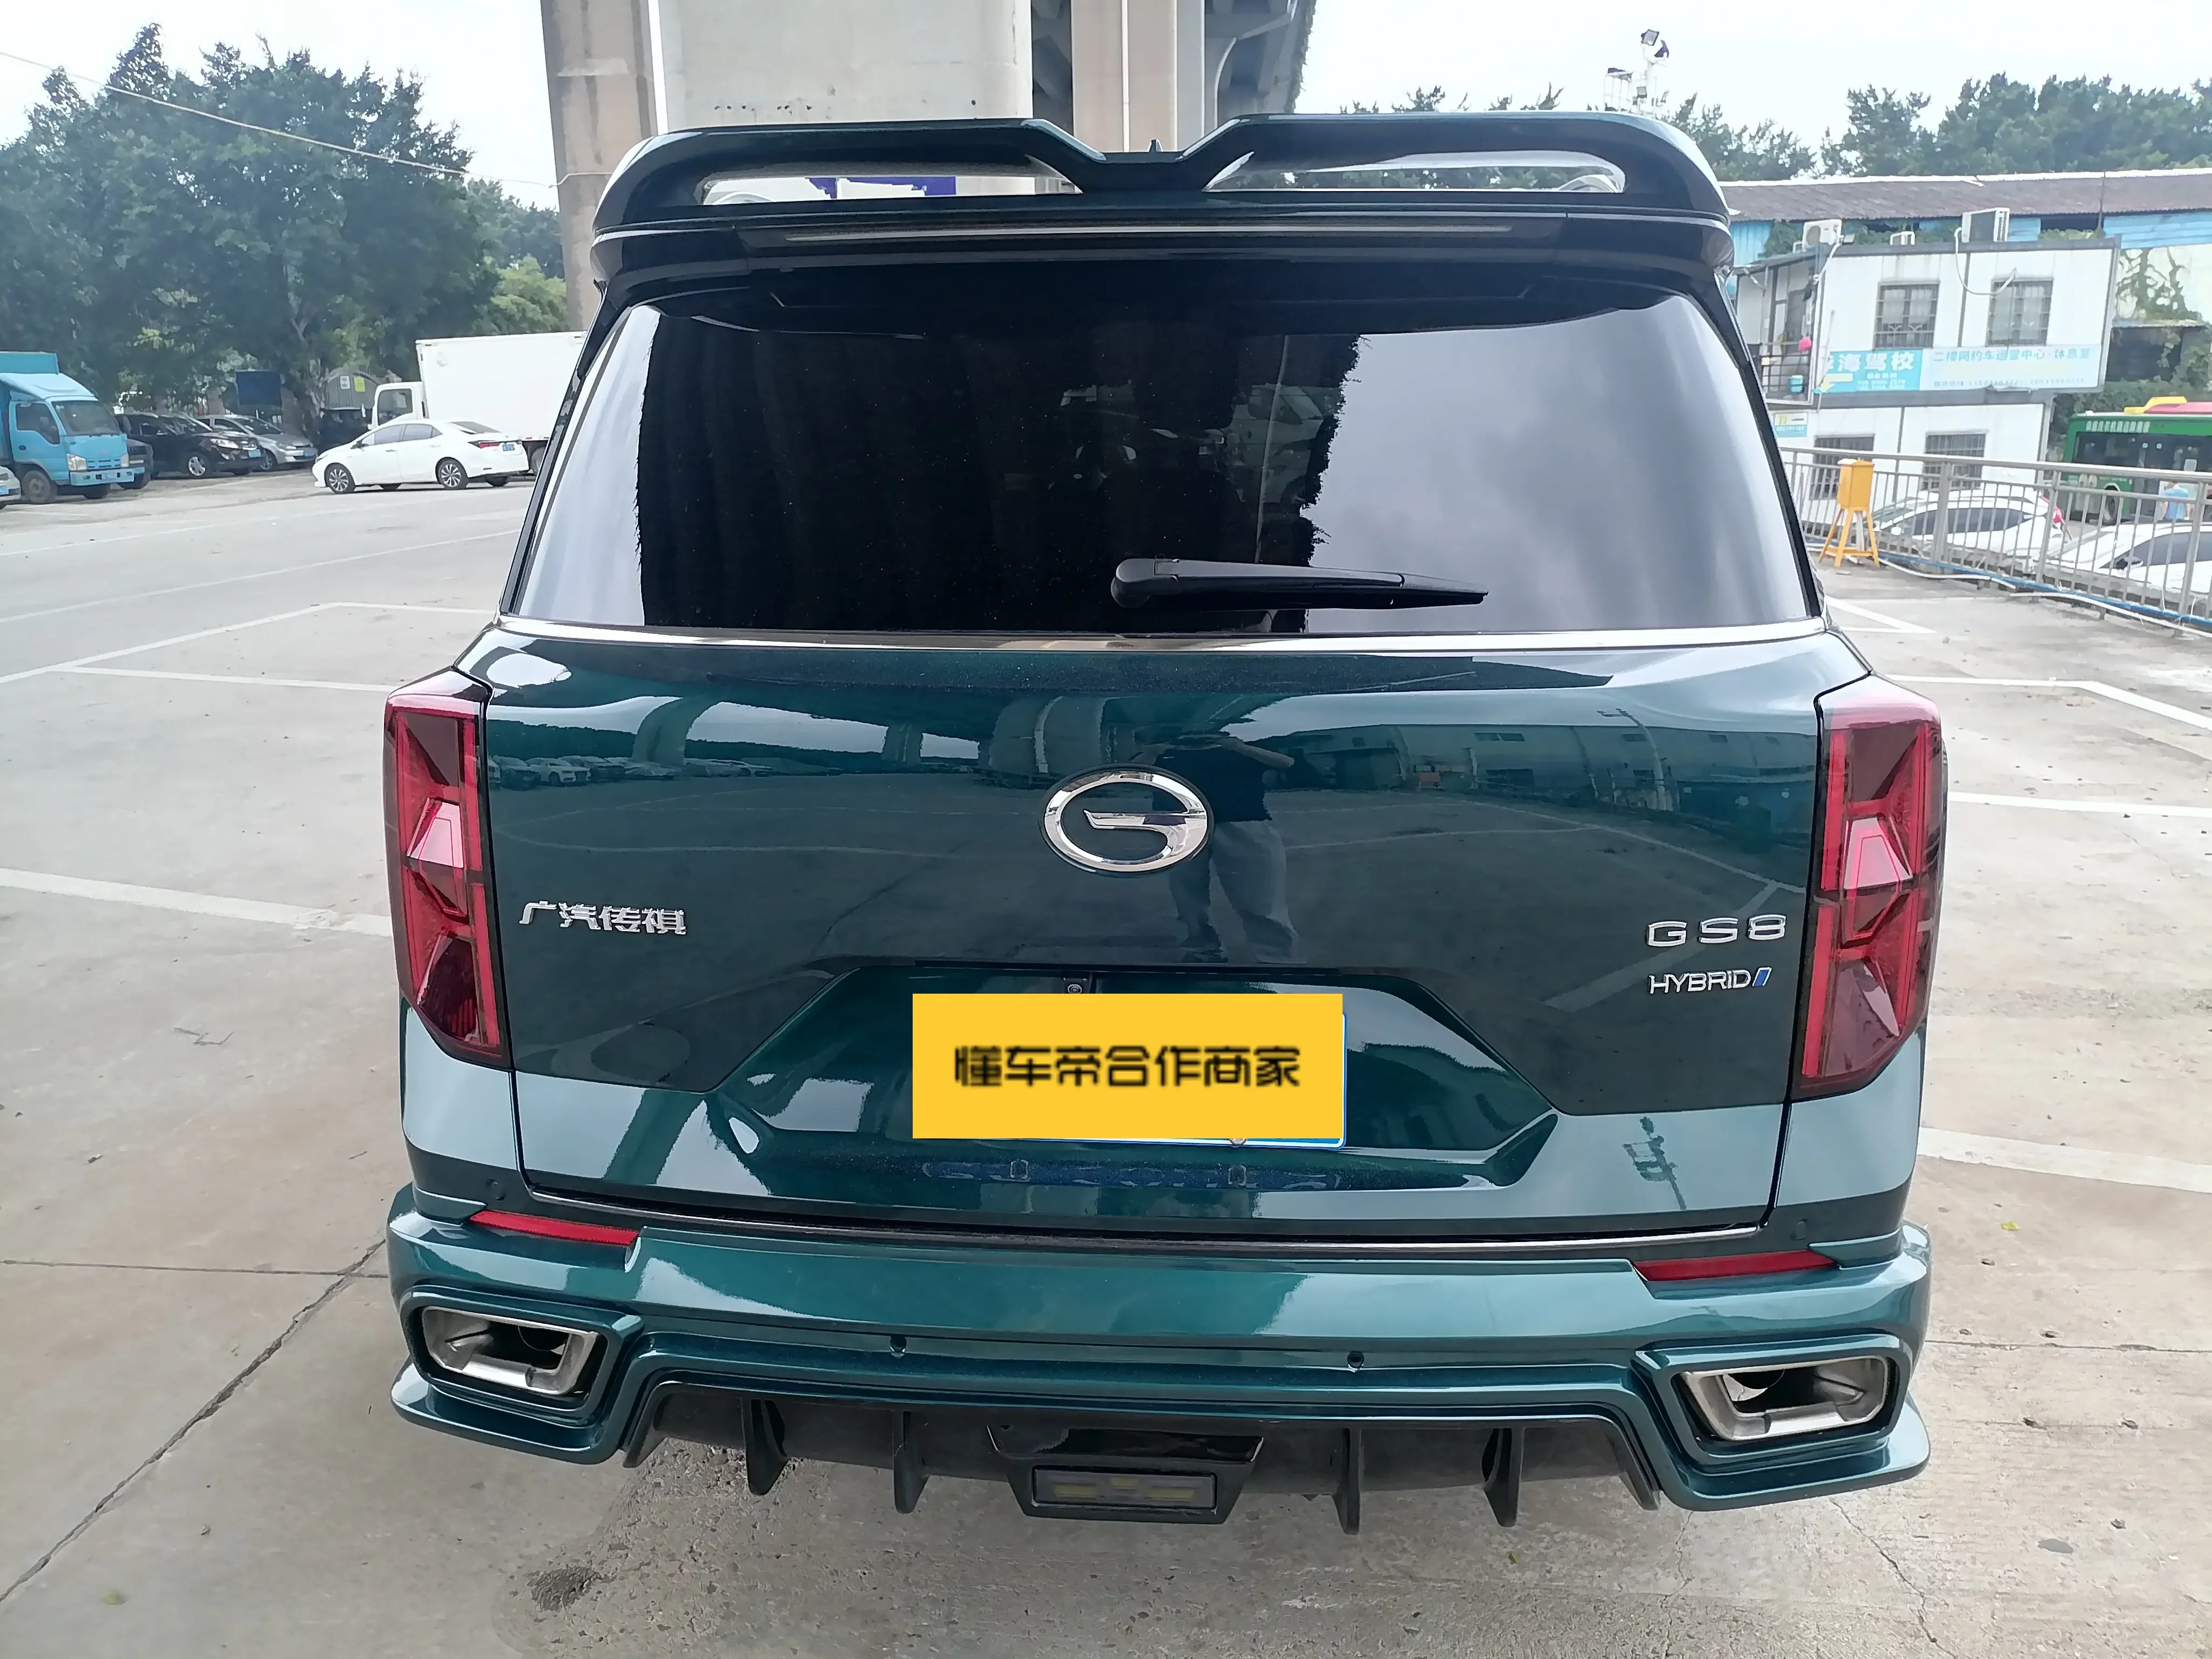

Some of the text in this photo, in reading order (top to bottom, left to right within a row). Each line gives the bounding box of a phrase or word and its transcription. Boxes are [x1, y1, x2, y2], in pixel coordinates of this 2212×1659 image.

[519, 901, 686, 934] 广汽传祺
[1647, 914, 1786, 947] GS8
[1649, 970, 1751, 994] HYBRID
